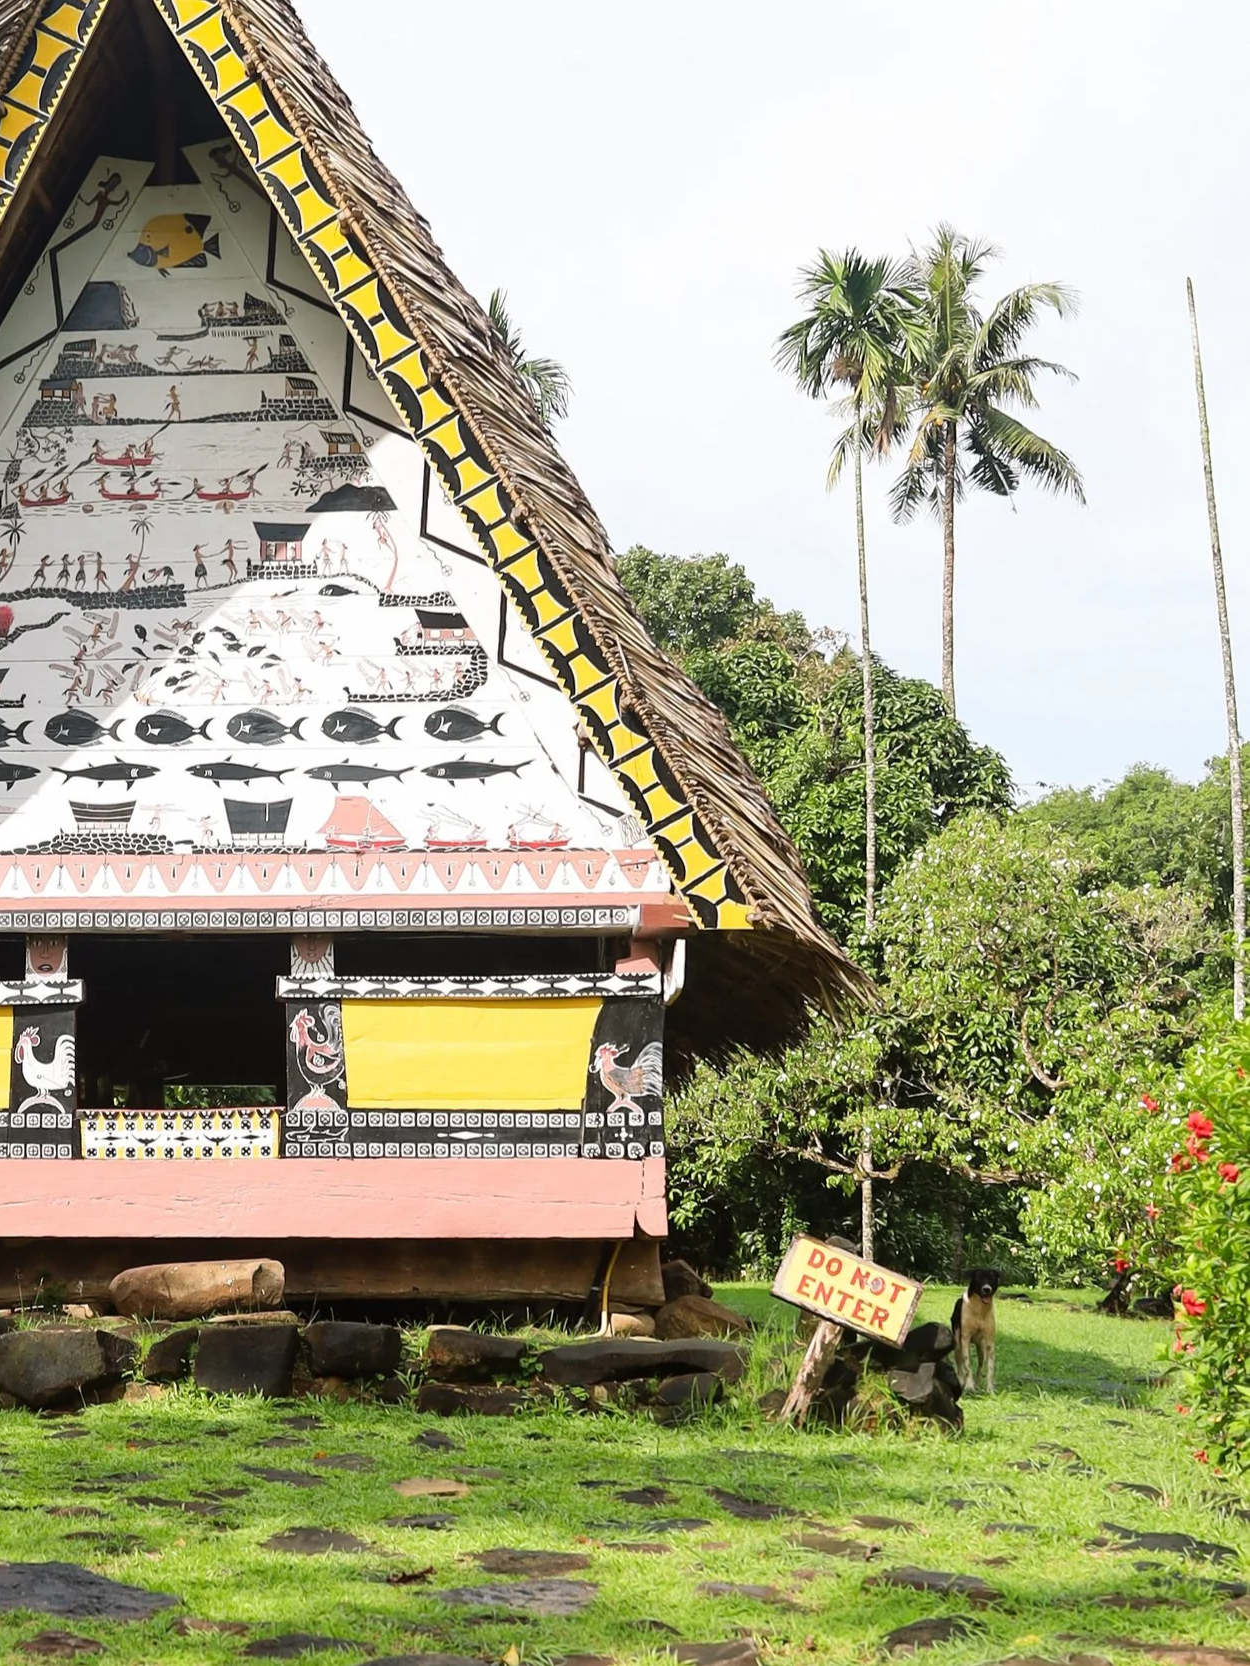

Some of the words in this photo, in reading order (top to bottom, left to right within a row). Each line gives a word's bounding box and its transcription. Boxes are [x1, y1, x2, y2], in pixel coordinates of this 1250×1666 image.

[796, 1274, 890, 1332] ENTER
[807, 1248, 843, 1277] DO
[850, 1266, 907, 1304] NOT
